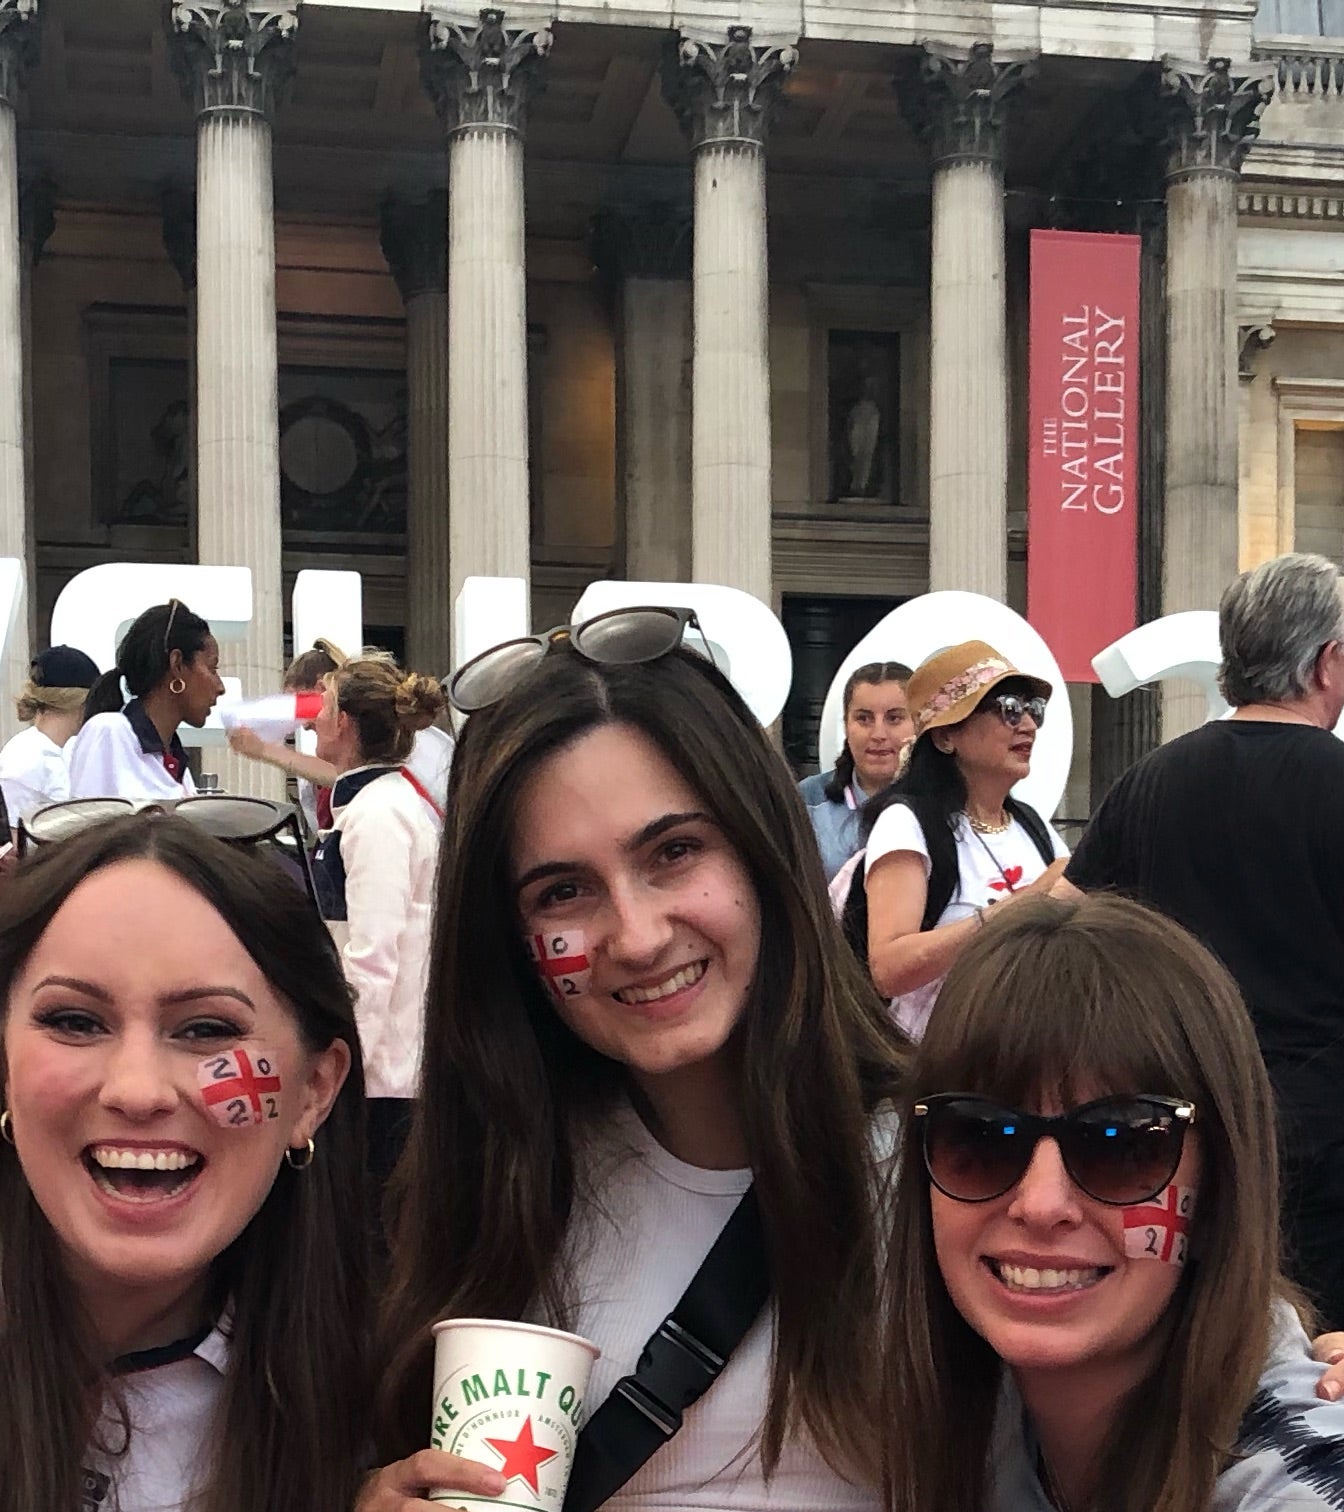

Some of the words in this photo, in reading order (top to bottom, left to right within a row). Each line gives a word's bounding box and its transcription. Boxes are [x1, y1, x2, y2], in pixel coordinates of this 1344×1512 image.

[1042, 417, 1058, 458] THE
[1060, 304, 1089, 513] NATIONAL
[1093, 306, 1126, 515] GALLERY
[460, 1368, 552, 1406] MALT
[558, 1385, 583, 1428] QU
